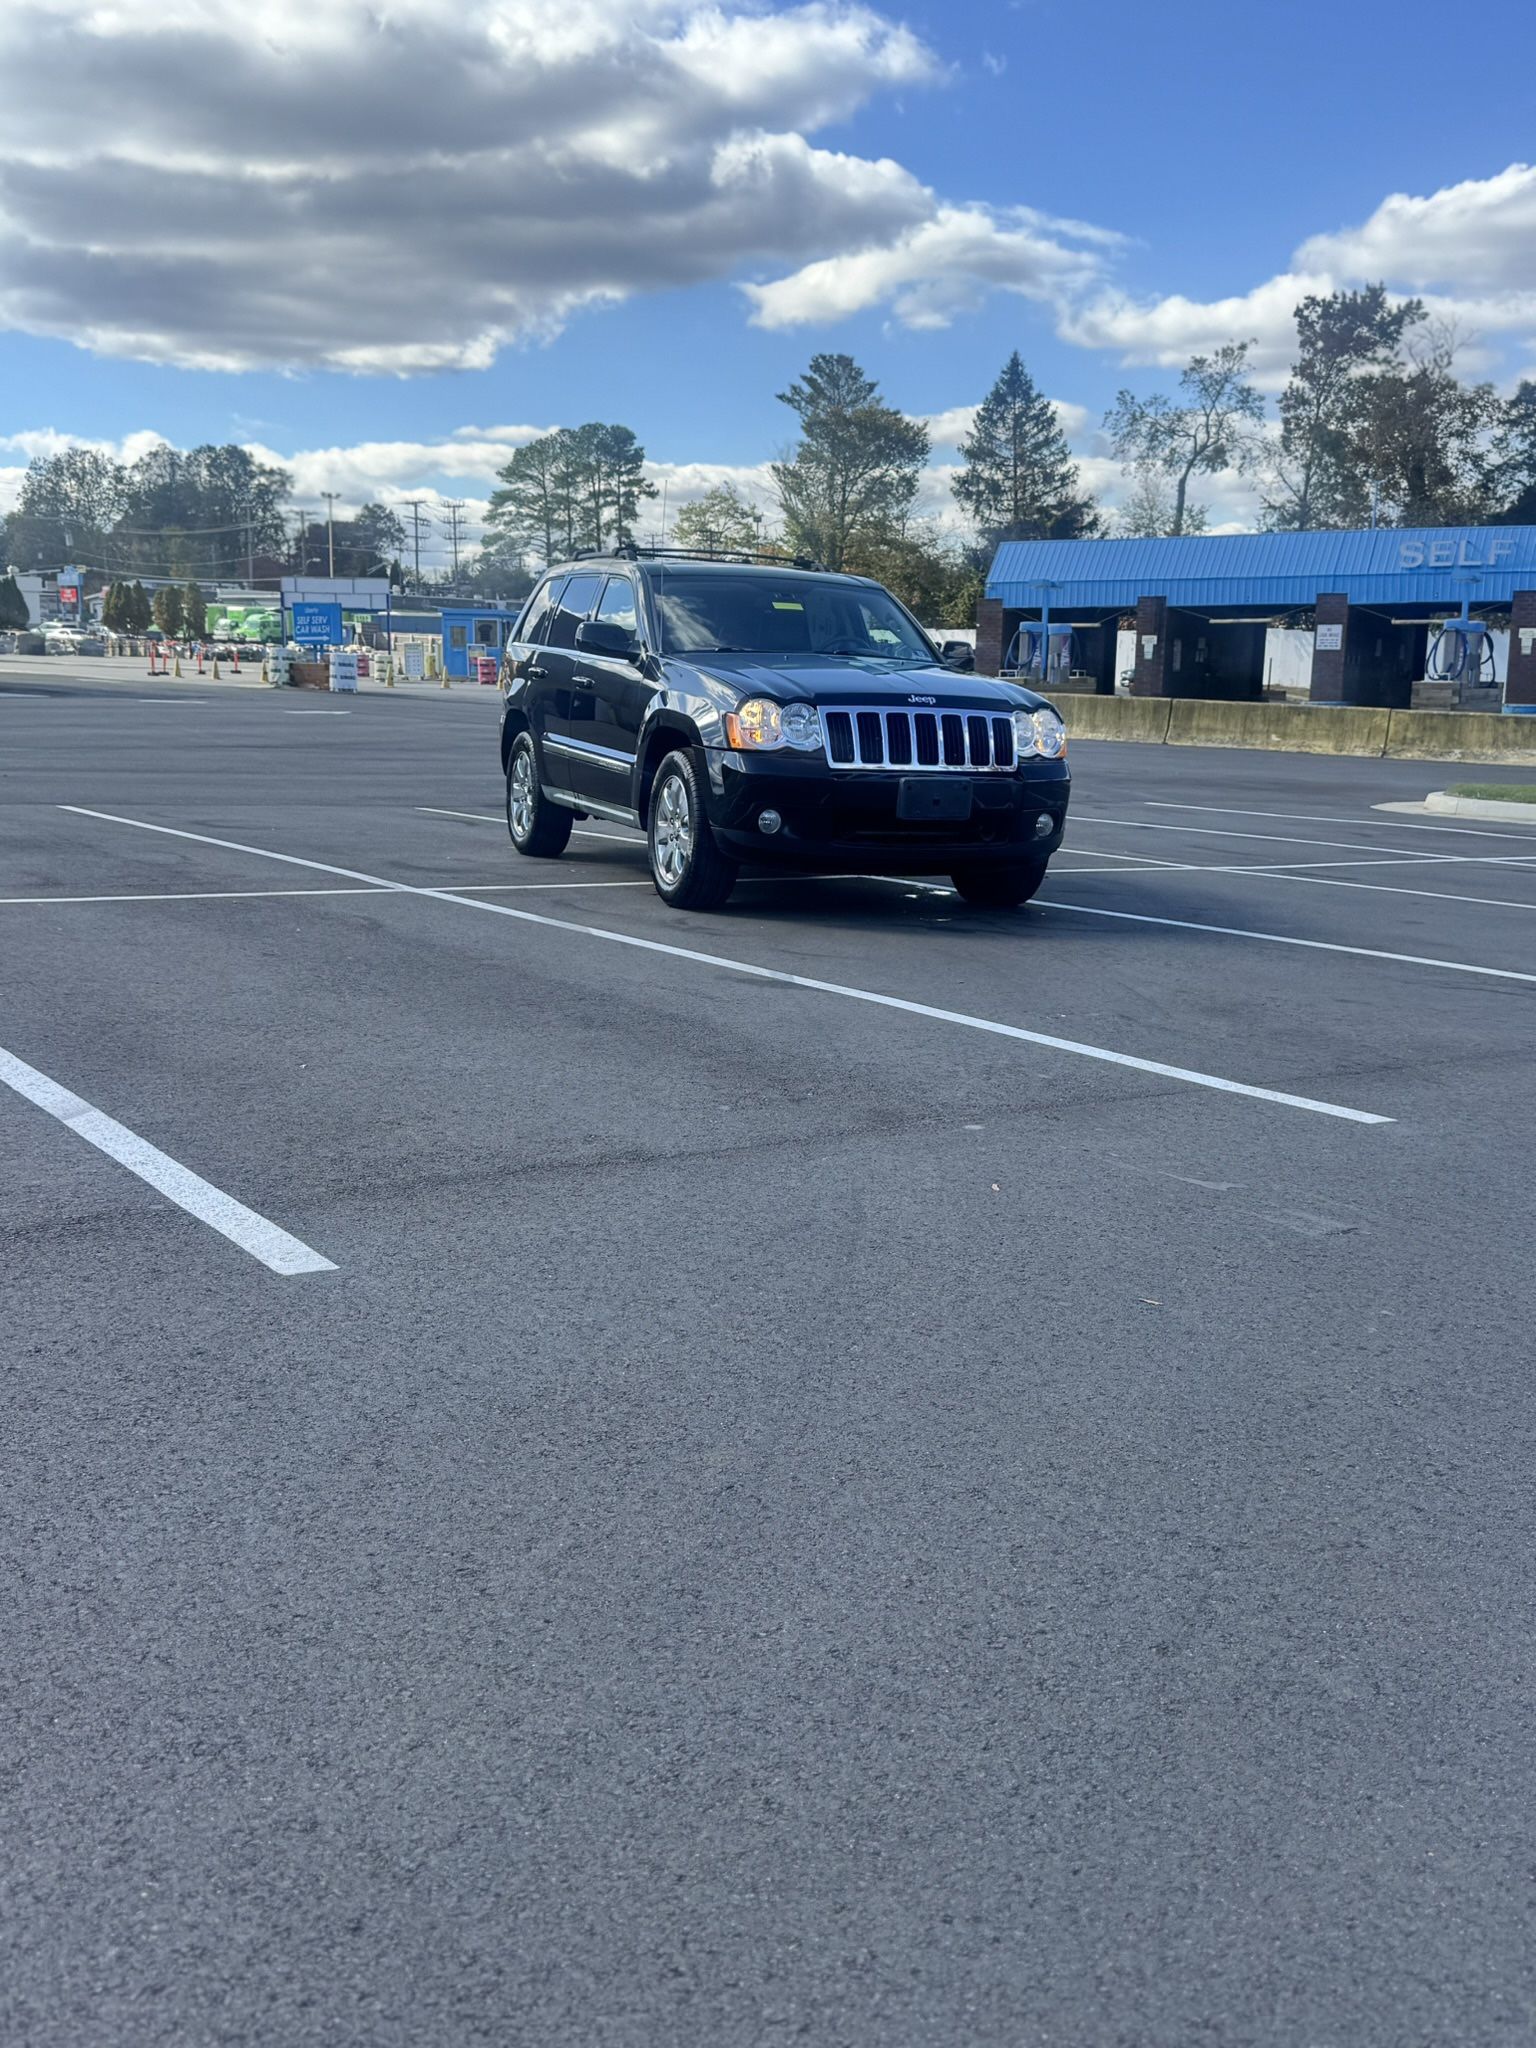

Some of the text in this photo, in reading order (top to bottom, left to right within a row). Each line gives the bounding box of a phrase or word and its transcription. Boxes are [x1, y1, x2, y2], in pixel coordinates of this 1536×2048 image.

[1399, 539, 1515, 569] SELF
[296, 616, 310, 625] SELF
[296, 624, 330, 634] CAR WASH
[908, 694, 936, 705] Jeep
